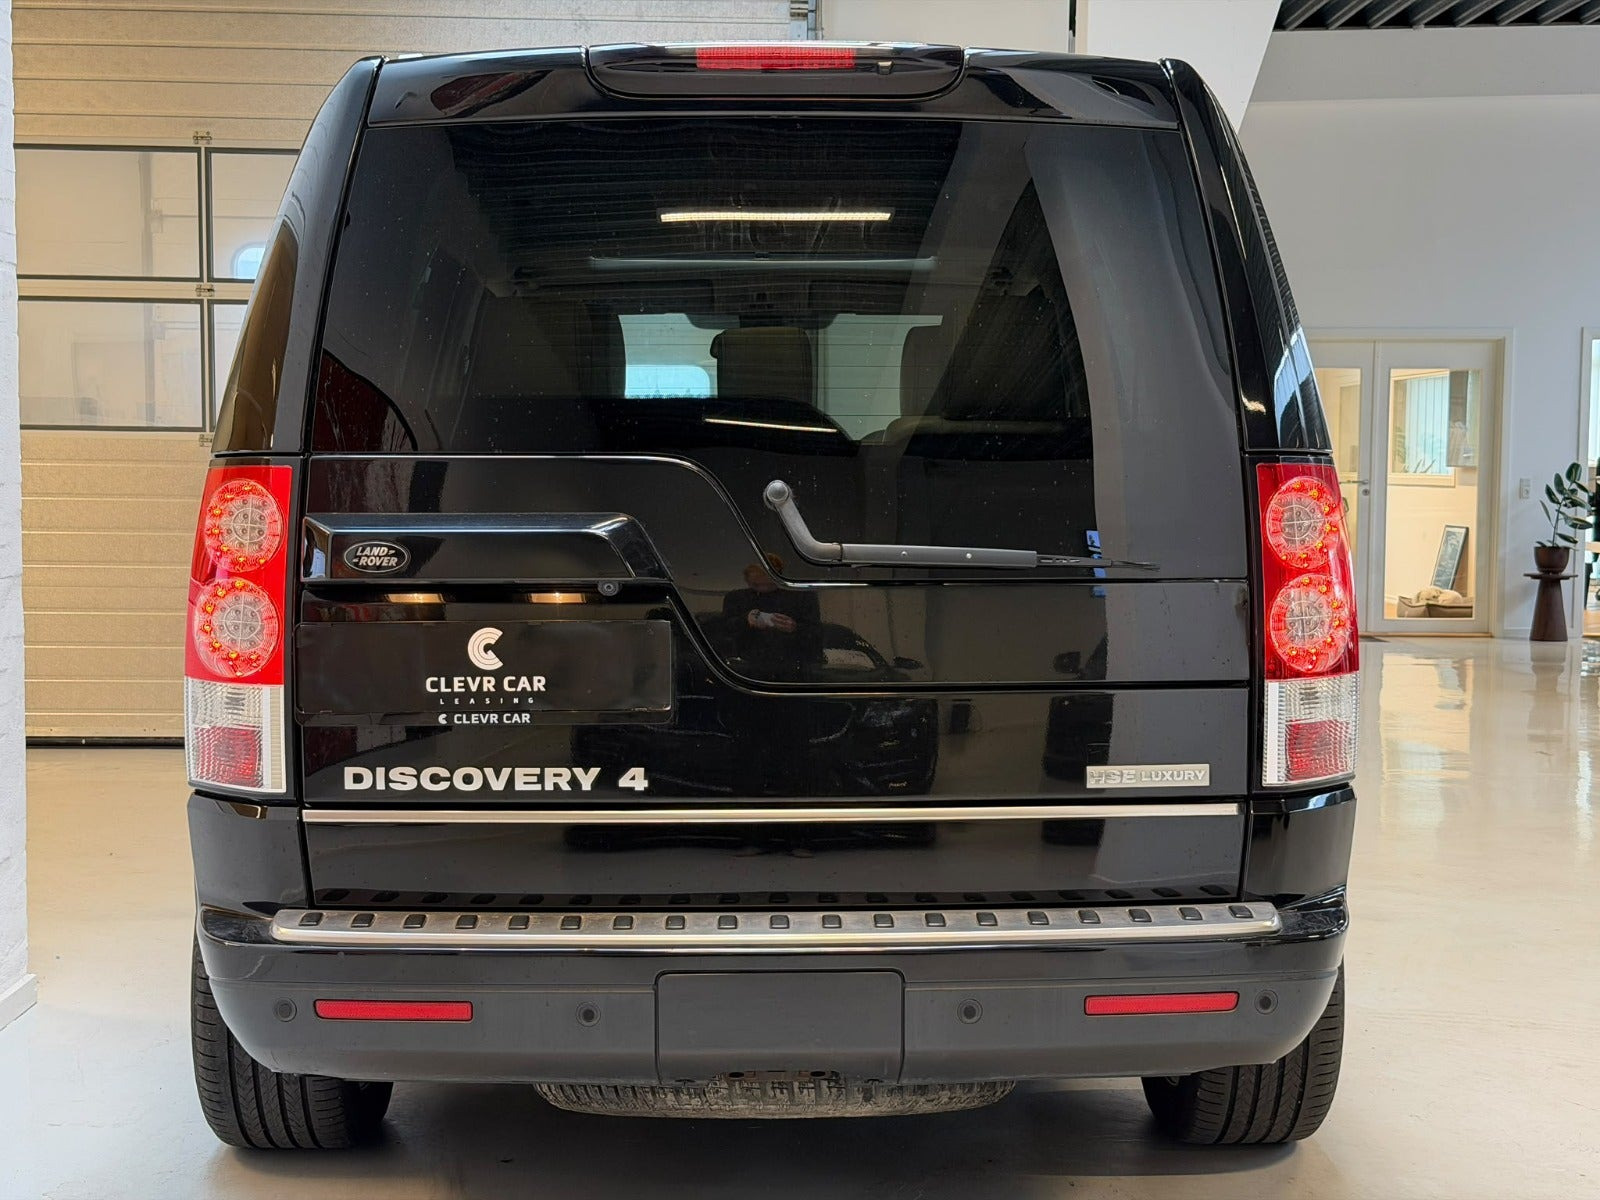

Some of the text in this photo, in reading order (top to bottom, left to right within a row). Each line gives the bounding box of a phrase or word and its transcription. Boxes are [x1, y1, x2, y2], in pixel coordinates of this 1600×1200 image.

[425, 676, 546, 692] CLEVR CAR
[454, 714, 499, 724] CLEVR
[503, 713, 531, 724] CAR
[344, 767, 648, 791] DISCOVERY 4
[1090, 769, 1206, 784] HSE LUXURY
